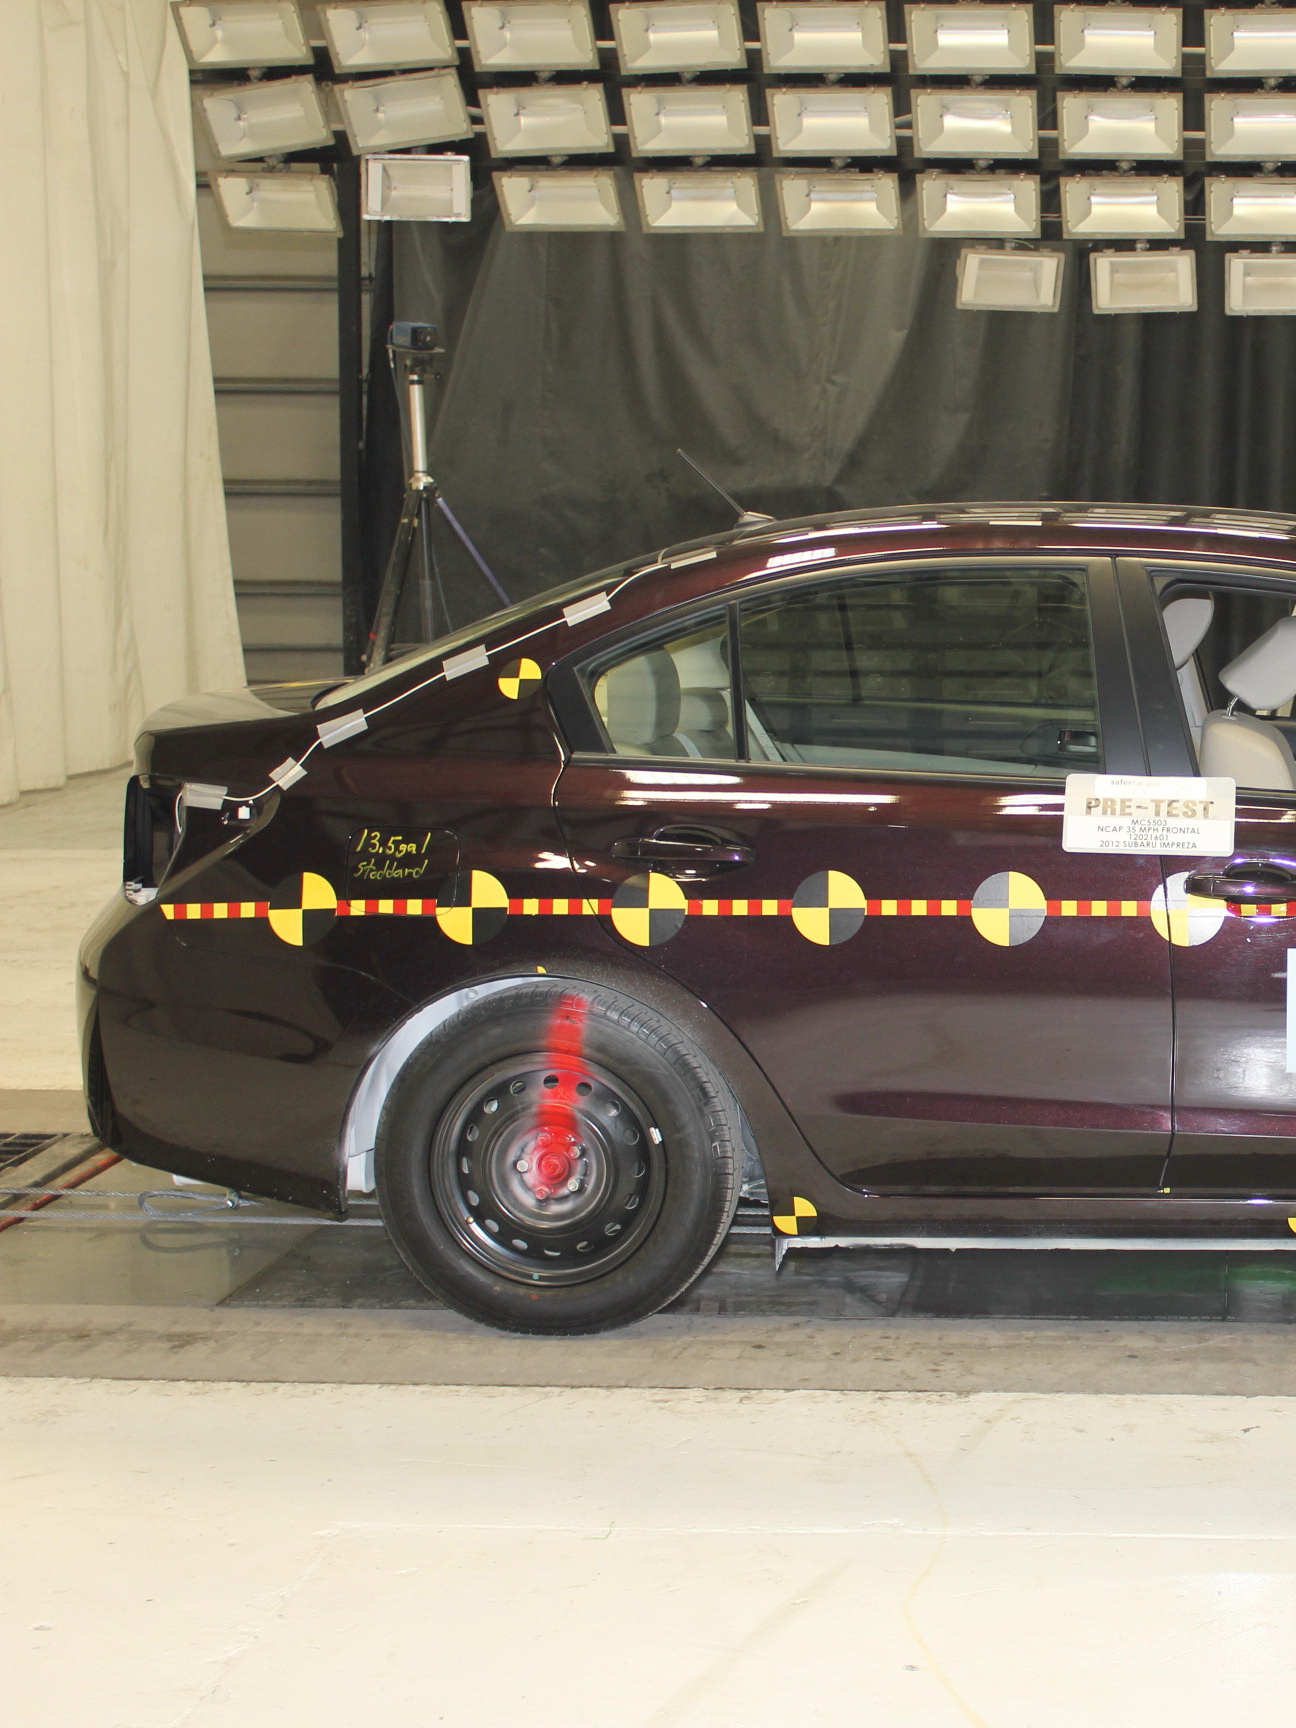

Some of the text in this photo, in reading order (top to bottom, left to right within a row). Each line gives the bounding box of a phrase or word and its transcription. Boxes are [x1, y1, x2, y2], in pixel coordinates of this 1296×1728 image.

[1110, 778, 1161, 788] safercar.gov
[1085, 797, 1214, 819] PRE-TEST
[1131, 819, 1168, 827] MC5503
[1097, 825, 1201, 835] NCAP 35 MPH FRONTAL
[1129, 833, 1169, 841] 12021601
[1099, 840, 1198, 849] 2012 SUBARU IMPREZA
